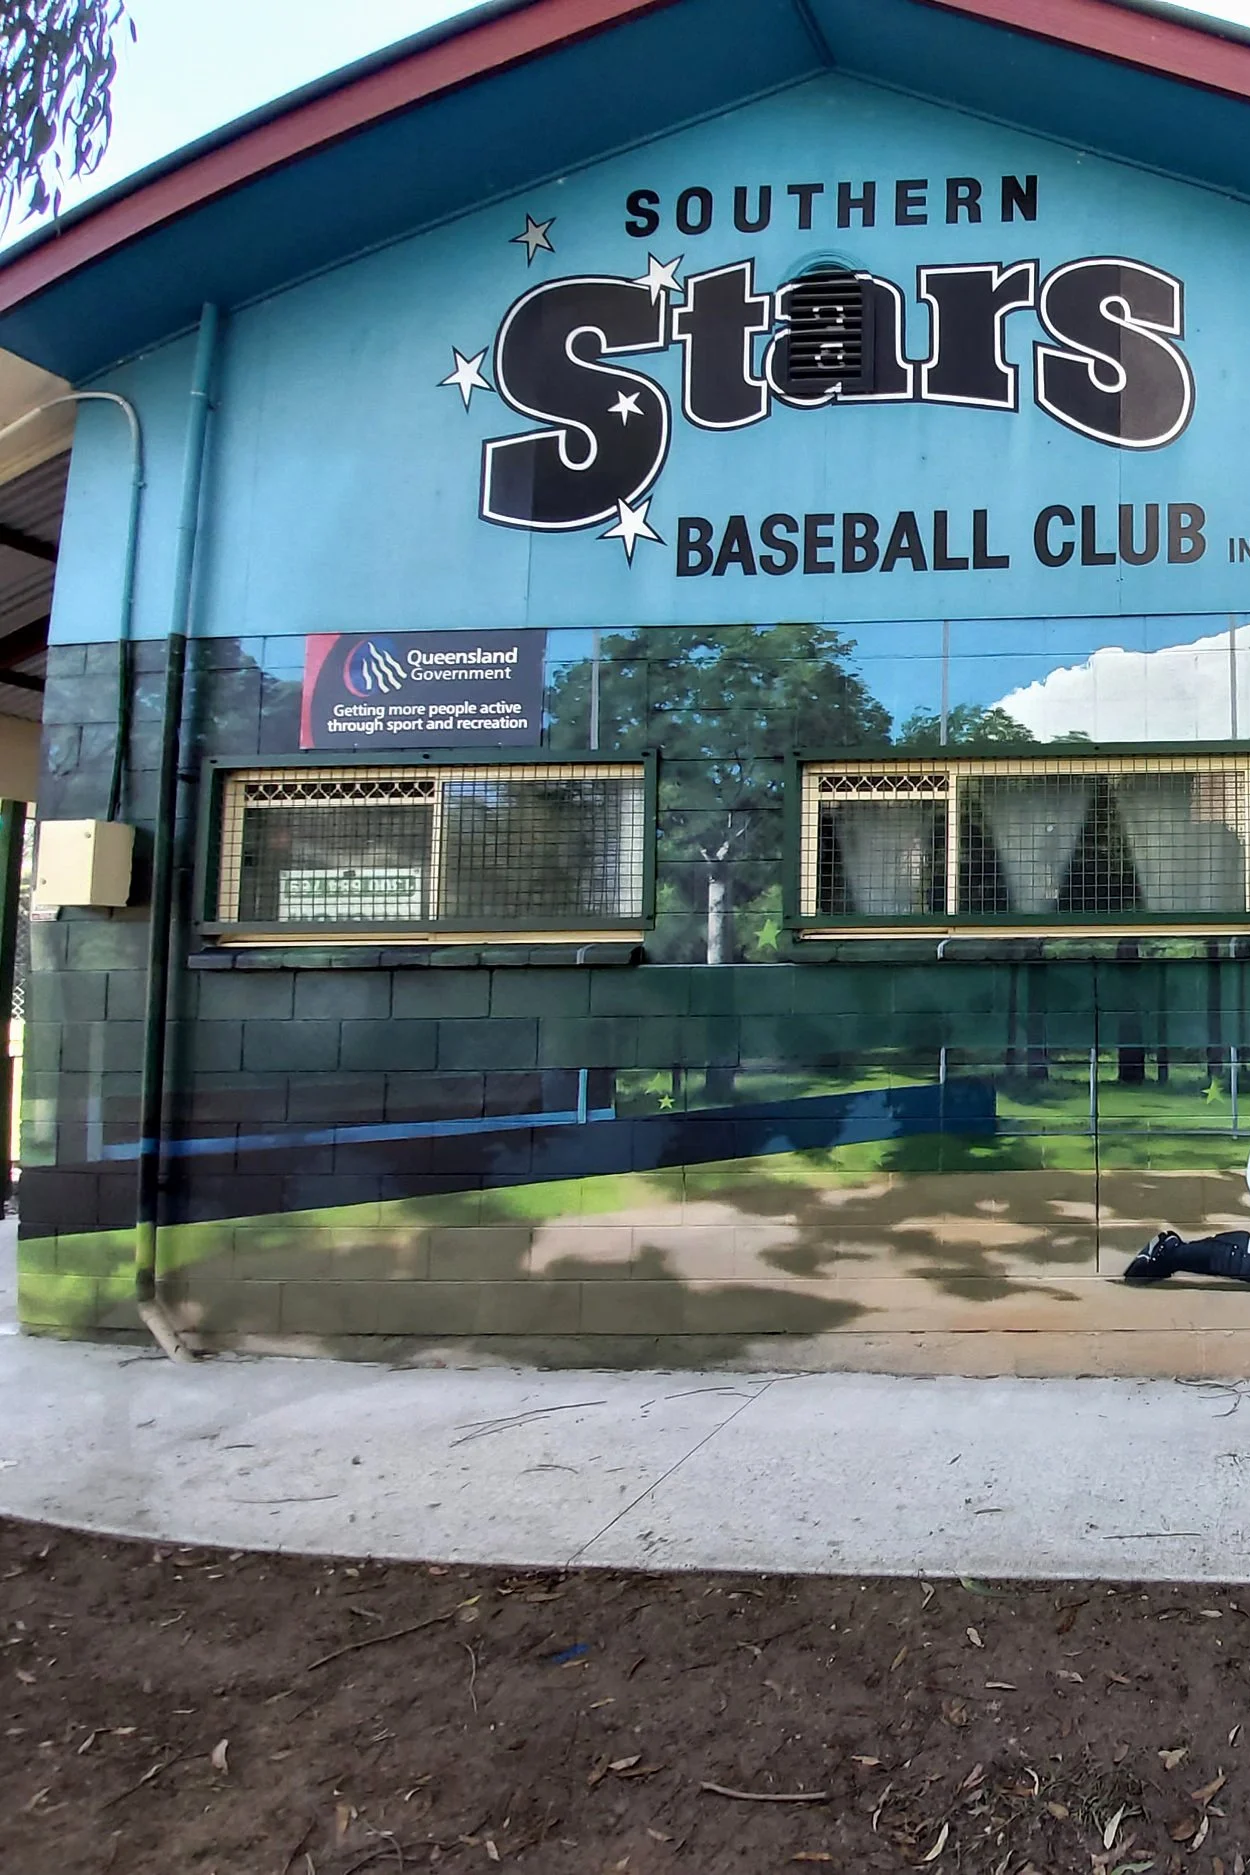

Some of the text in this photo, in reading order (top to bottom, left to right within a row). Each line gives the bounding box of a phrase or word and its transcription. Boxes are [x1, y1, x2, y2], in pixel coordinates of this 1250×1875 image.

[624, 174, 1039, 239] SOUTHERN
[479, 256, 1194, 531] Stars
[675, 512, 1010, 578] BASEBALL
[1034, 503, 1207, 569] CLUB
[407, 646, 518, 667] Queensland
[411, 666, 512, 681] Government
[333, 700, 522, 719] Getting more people active
[327, 715, 528, 735] through sport and recreation
